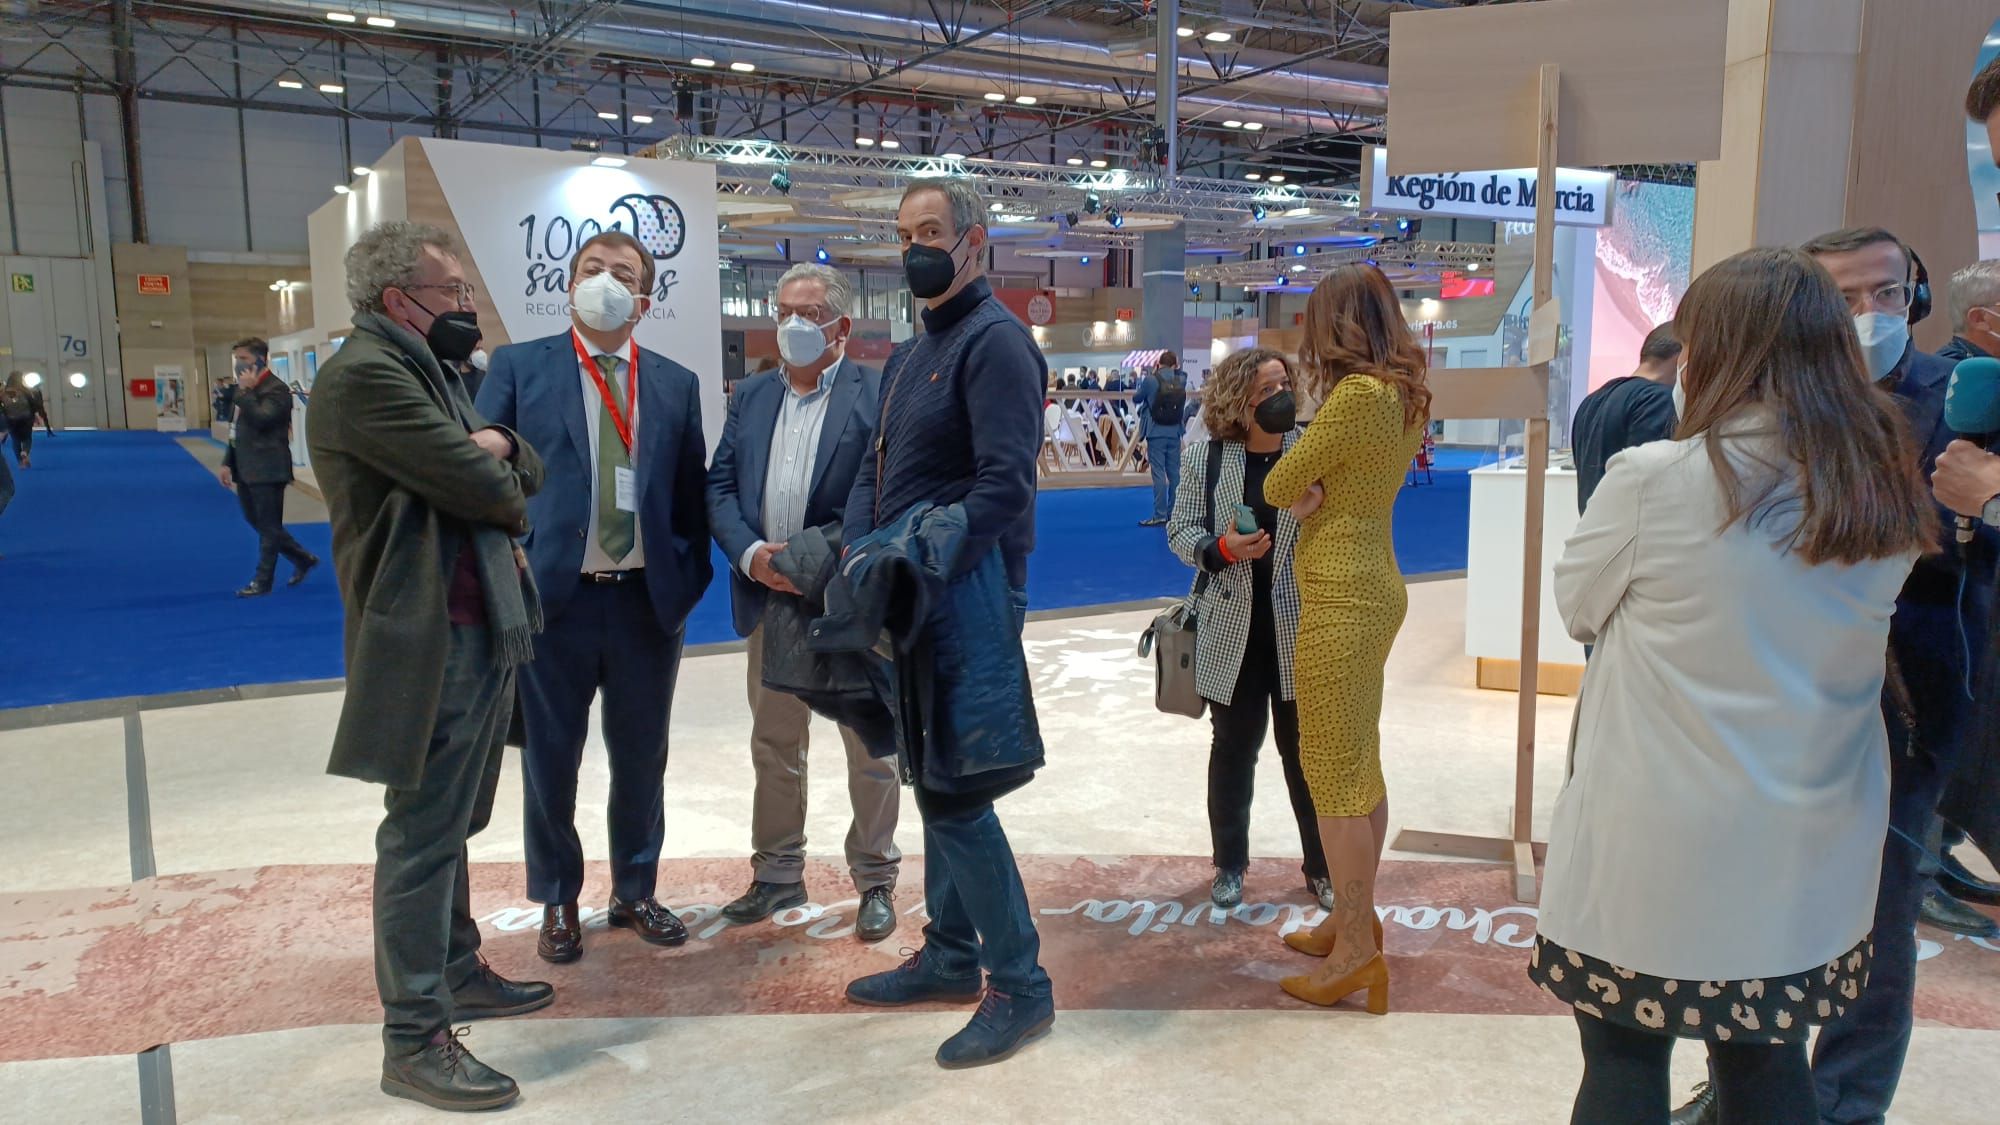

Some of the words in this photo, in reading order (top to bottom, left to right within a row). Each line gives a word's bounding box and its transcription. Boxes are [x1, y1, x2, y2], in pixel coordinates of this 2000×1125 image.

[1386, 174, 1476, 210] Región
[1481, 175, 1511, 206] de
[1516, 177, 1595, 212] Mrcia
[60, 335, 87, 357] 7g
